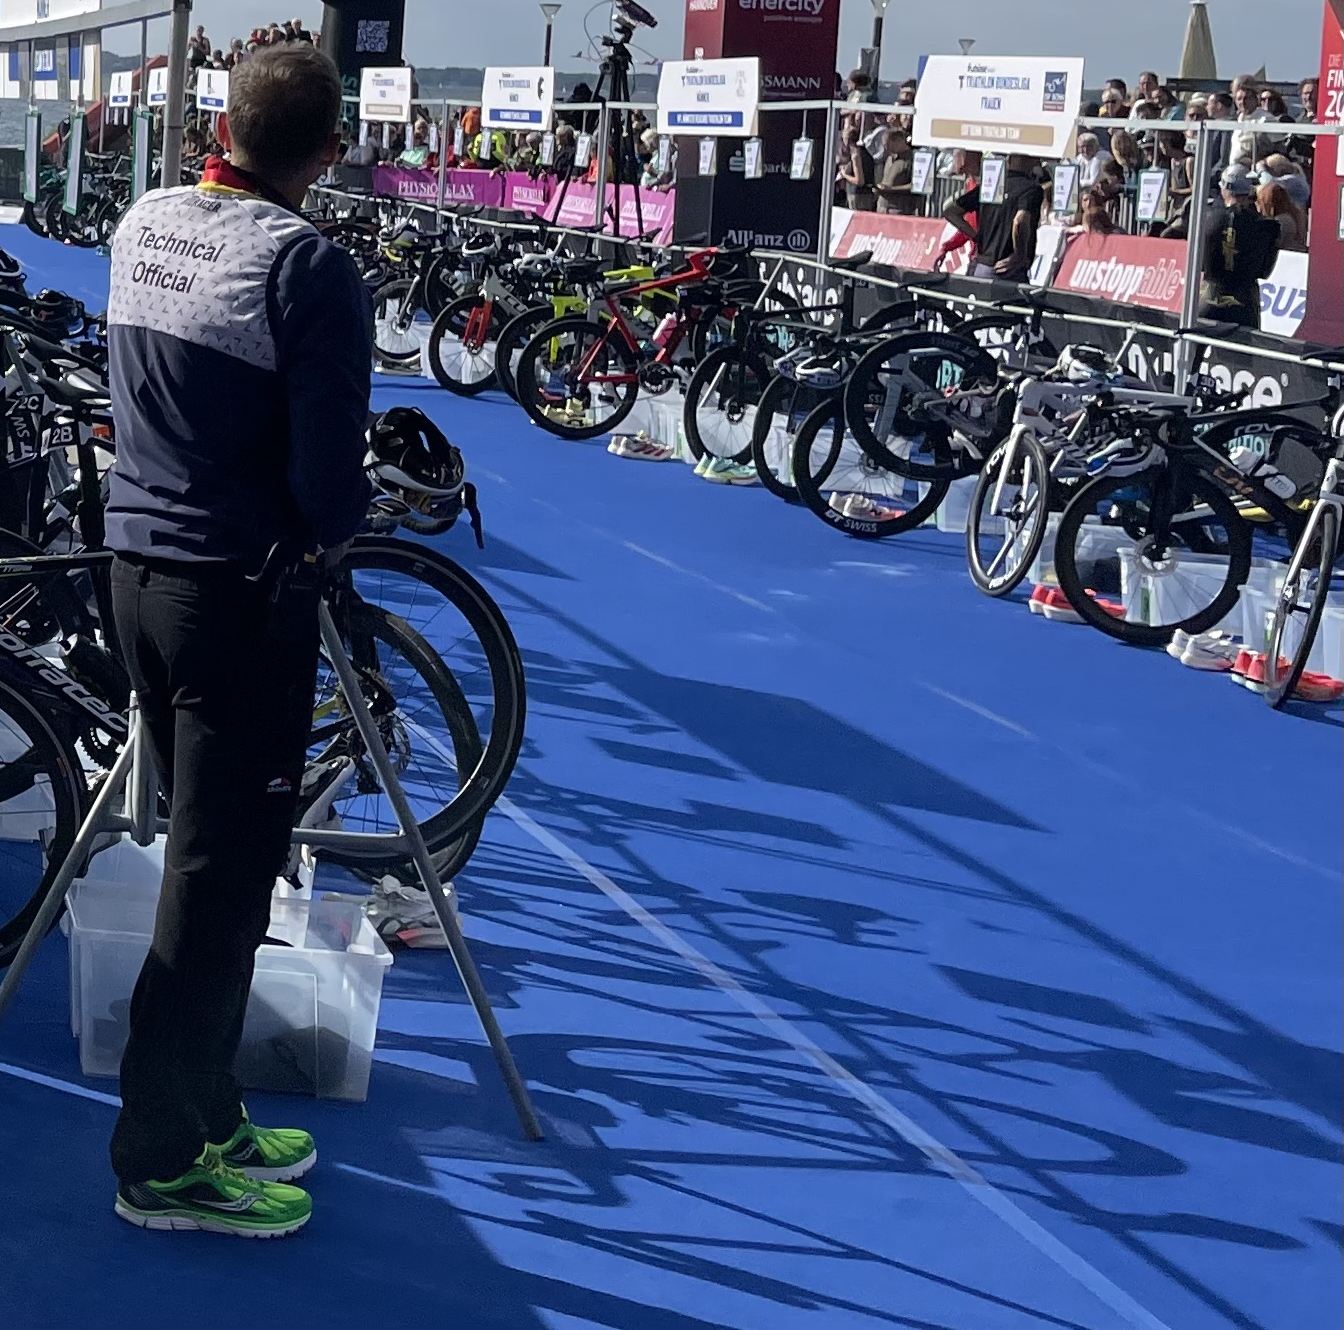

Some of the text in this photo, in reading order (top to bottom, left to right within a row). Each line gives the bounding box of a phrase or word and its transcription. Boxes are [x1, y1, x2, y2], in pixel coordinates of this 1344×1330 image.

[398, 180, 474, 201] PHYSIOELAX
[137, 226, 226, 263] Technical
[132, 260, 198, 295] Official
[1070, 254, 1181, 302] unstoppable
[51, 425, 73, 445] 2B
[825, 508, 878, 533] DT SWISS
